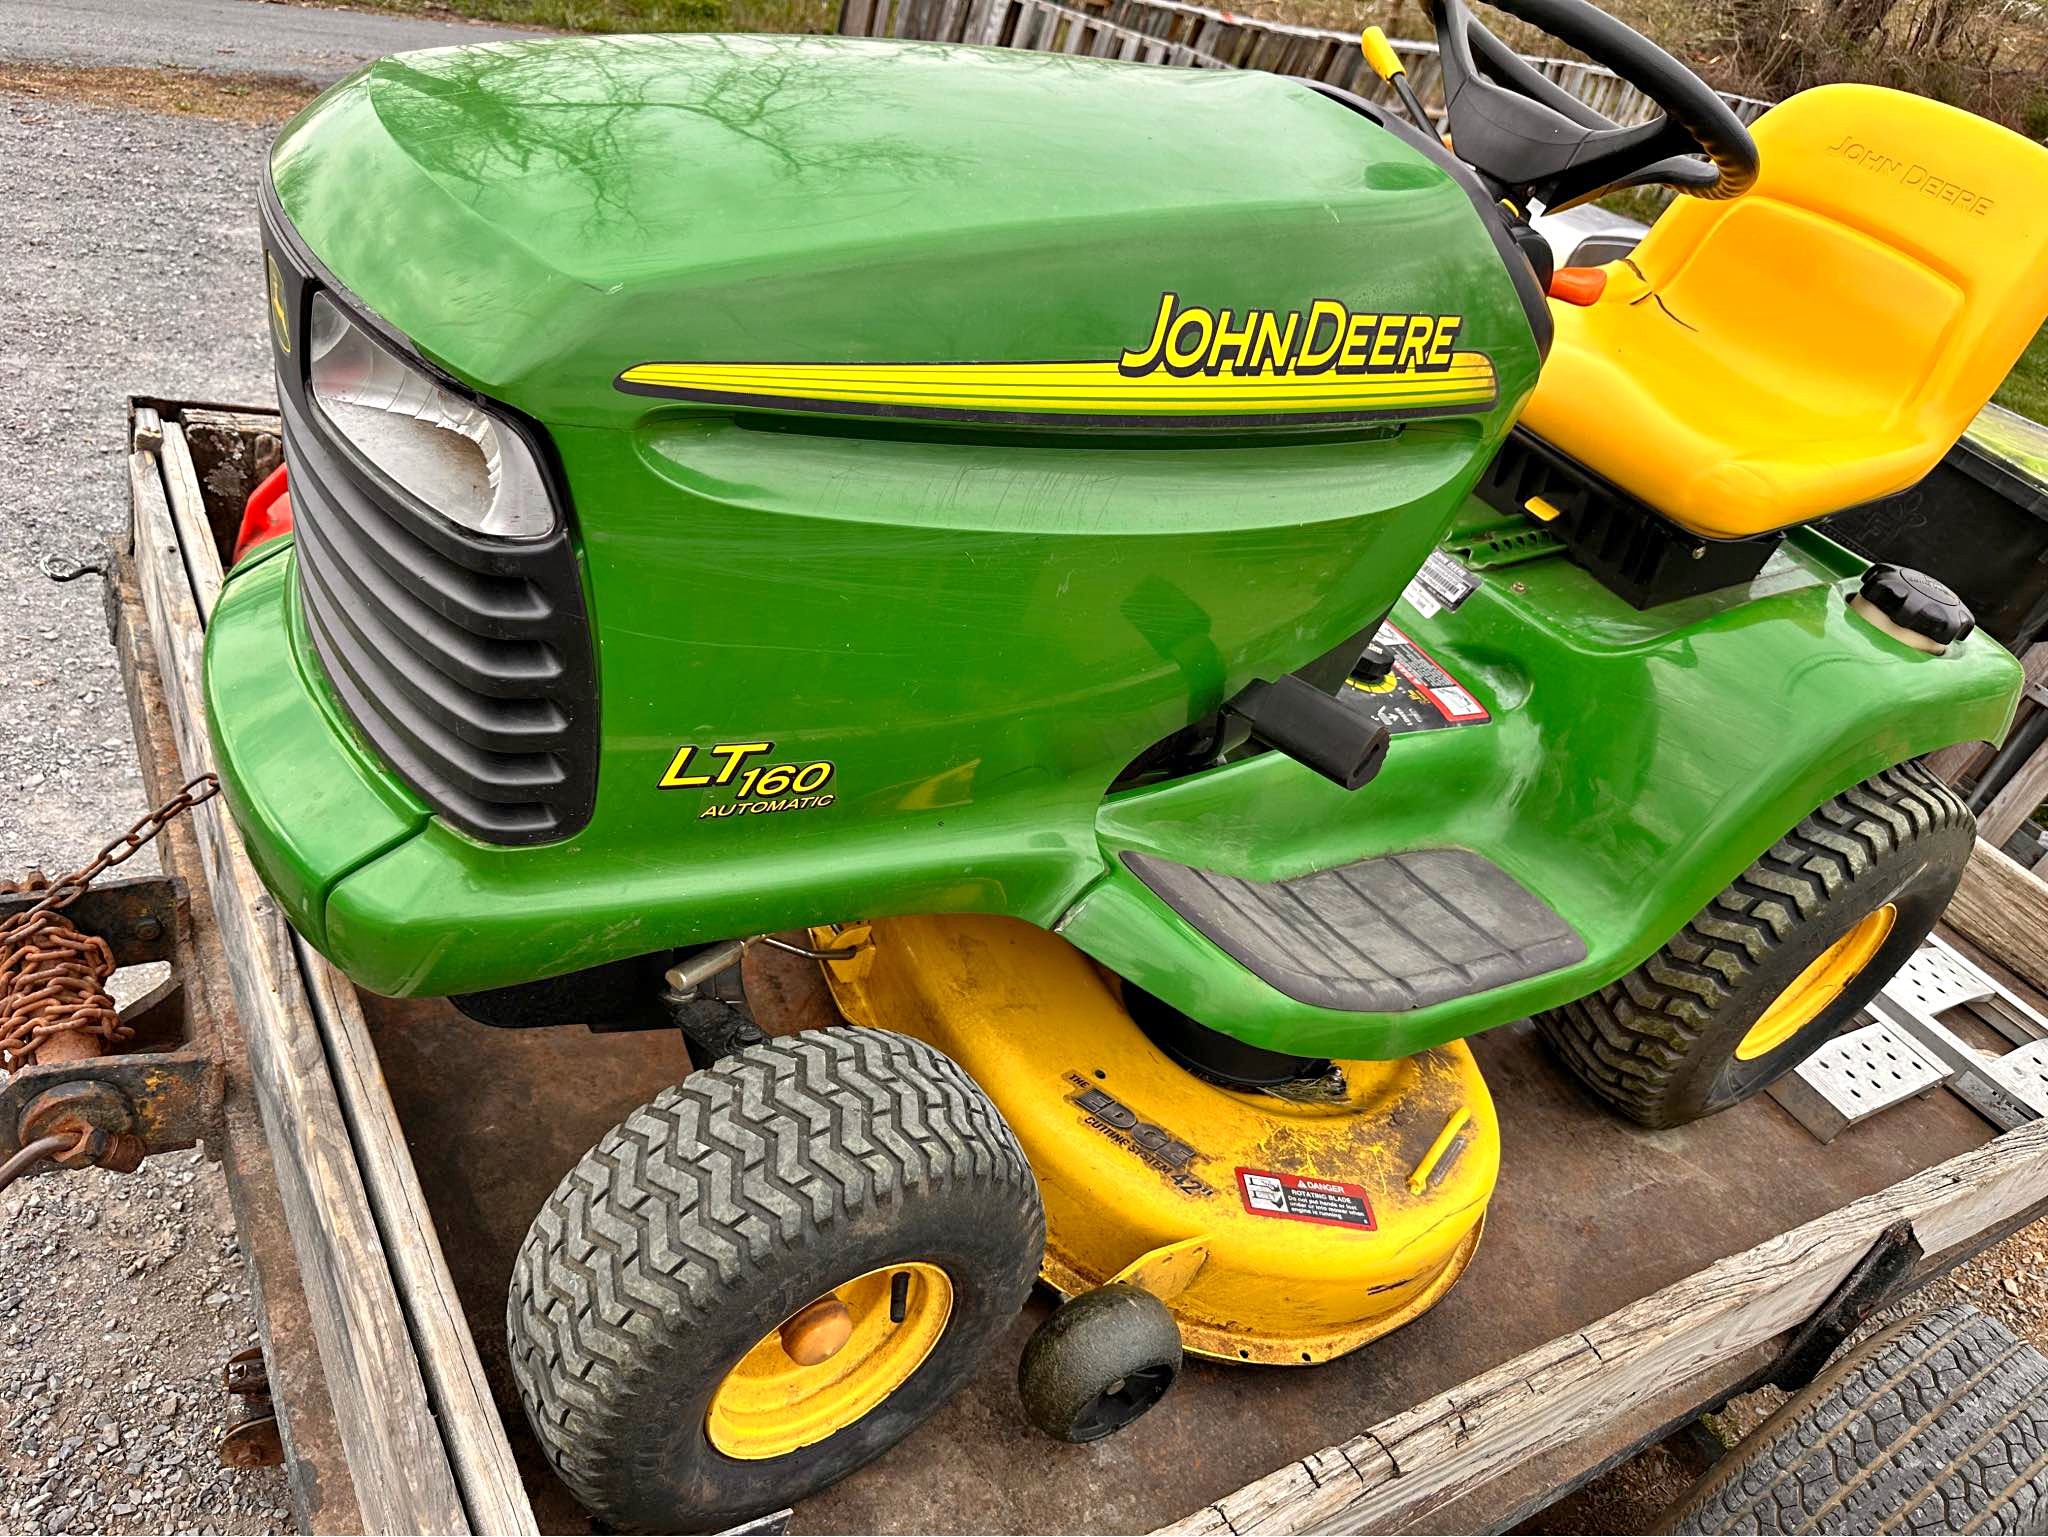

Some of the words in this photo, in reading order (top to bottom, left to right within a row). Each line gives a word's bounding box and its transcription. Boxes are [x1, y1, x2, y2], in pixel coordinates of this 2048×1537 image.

[1827, 135, 1902, 175] JOHN
[1899, 164, 1995, 216] DEERE
[1118, 291, 1300, 378] JOHN
[1294, 298, 1464, 374] DEERE
[699, 794, 836, 820] AUTOMATIC
[1069, 1073, 1090, 1088] THE
[1071, 1087, 1197, 1168] EDGE
[1128, 1143, 1173, 1174] SYSTEM
[1291, 1189, 1327, 1200] ROTATING
[1328, 1194, 1352, 1204] BLADE
[1307, 1181, 1345, 1194] DANGER
